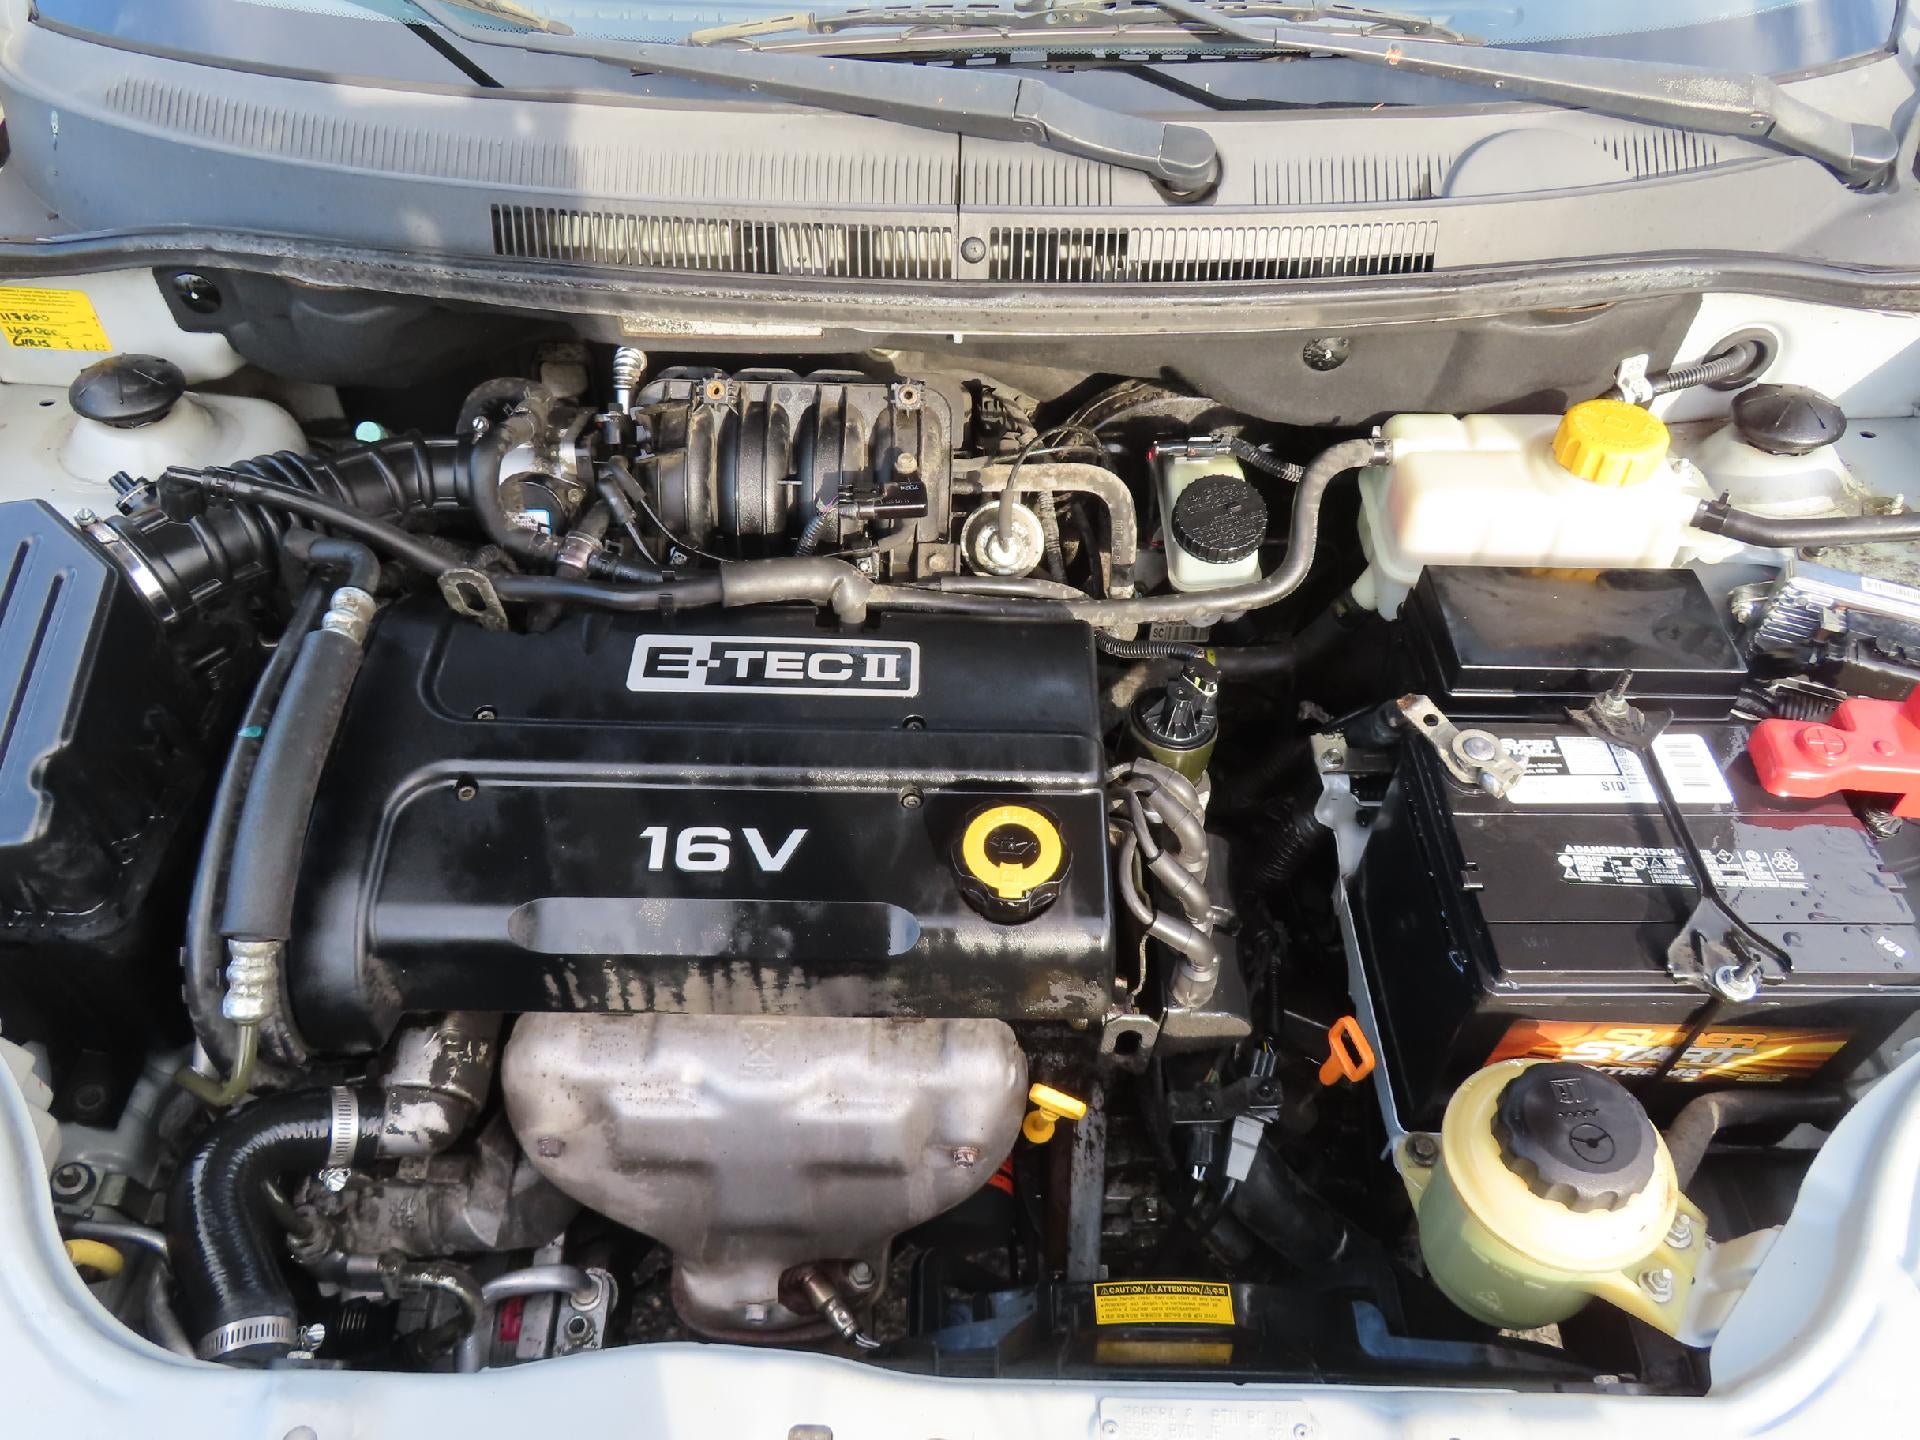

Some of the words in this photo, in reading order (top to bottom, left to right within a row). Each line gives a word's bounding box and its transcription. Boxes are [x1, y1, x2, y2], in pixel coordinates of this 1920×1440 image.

[13, 336, 52, 348] CHRIS
[640, 827, 809, 873] 16V
[1561, 1041, 1756, 1062] START
